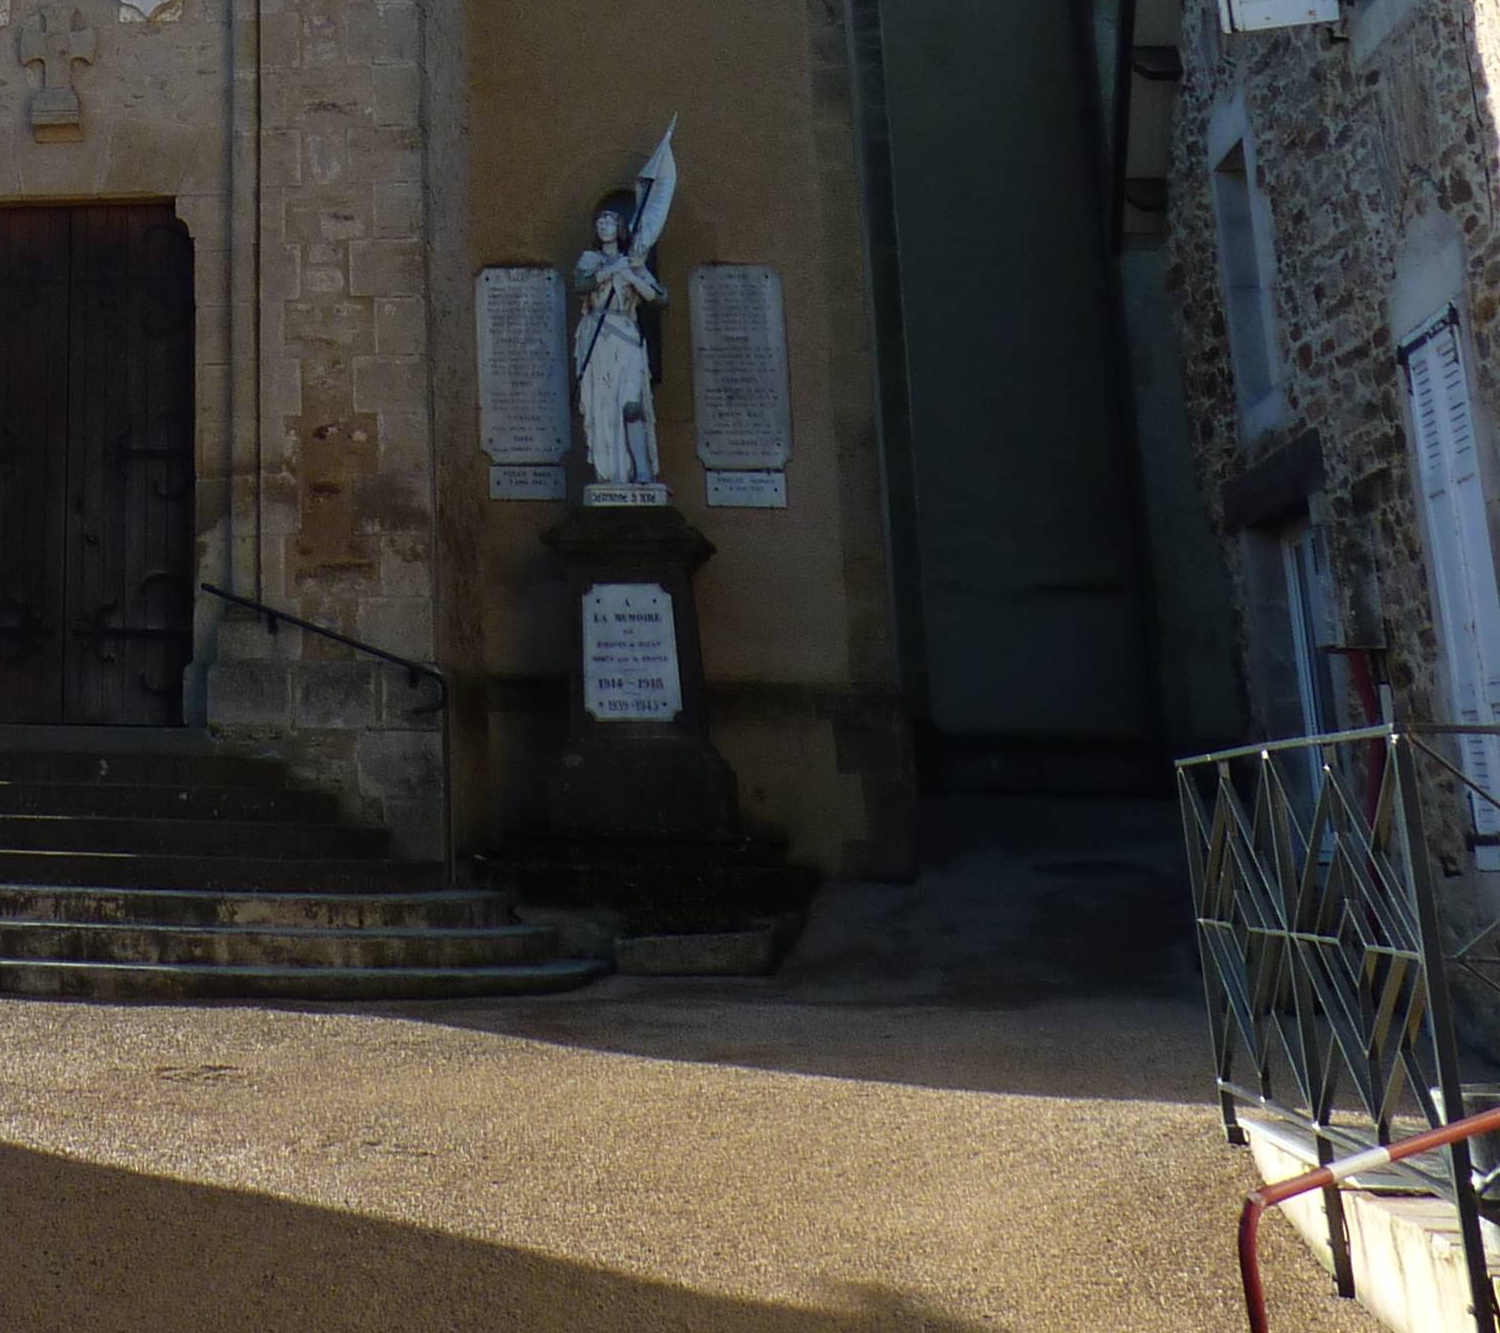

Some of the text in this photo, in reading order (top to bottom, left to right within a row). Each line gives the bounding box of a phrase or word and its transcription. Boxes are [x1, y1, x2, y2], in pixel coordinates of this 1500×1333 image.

[593, 613, 608, 623] LA
[598, 677, 623, 689] 1914
[637, 677, 664, 689] 1918
